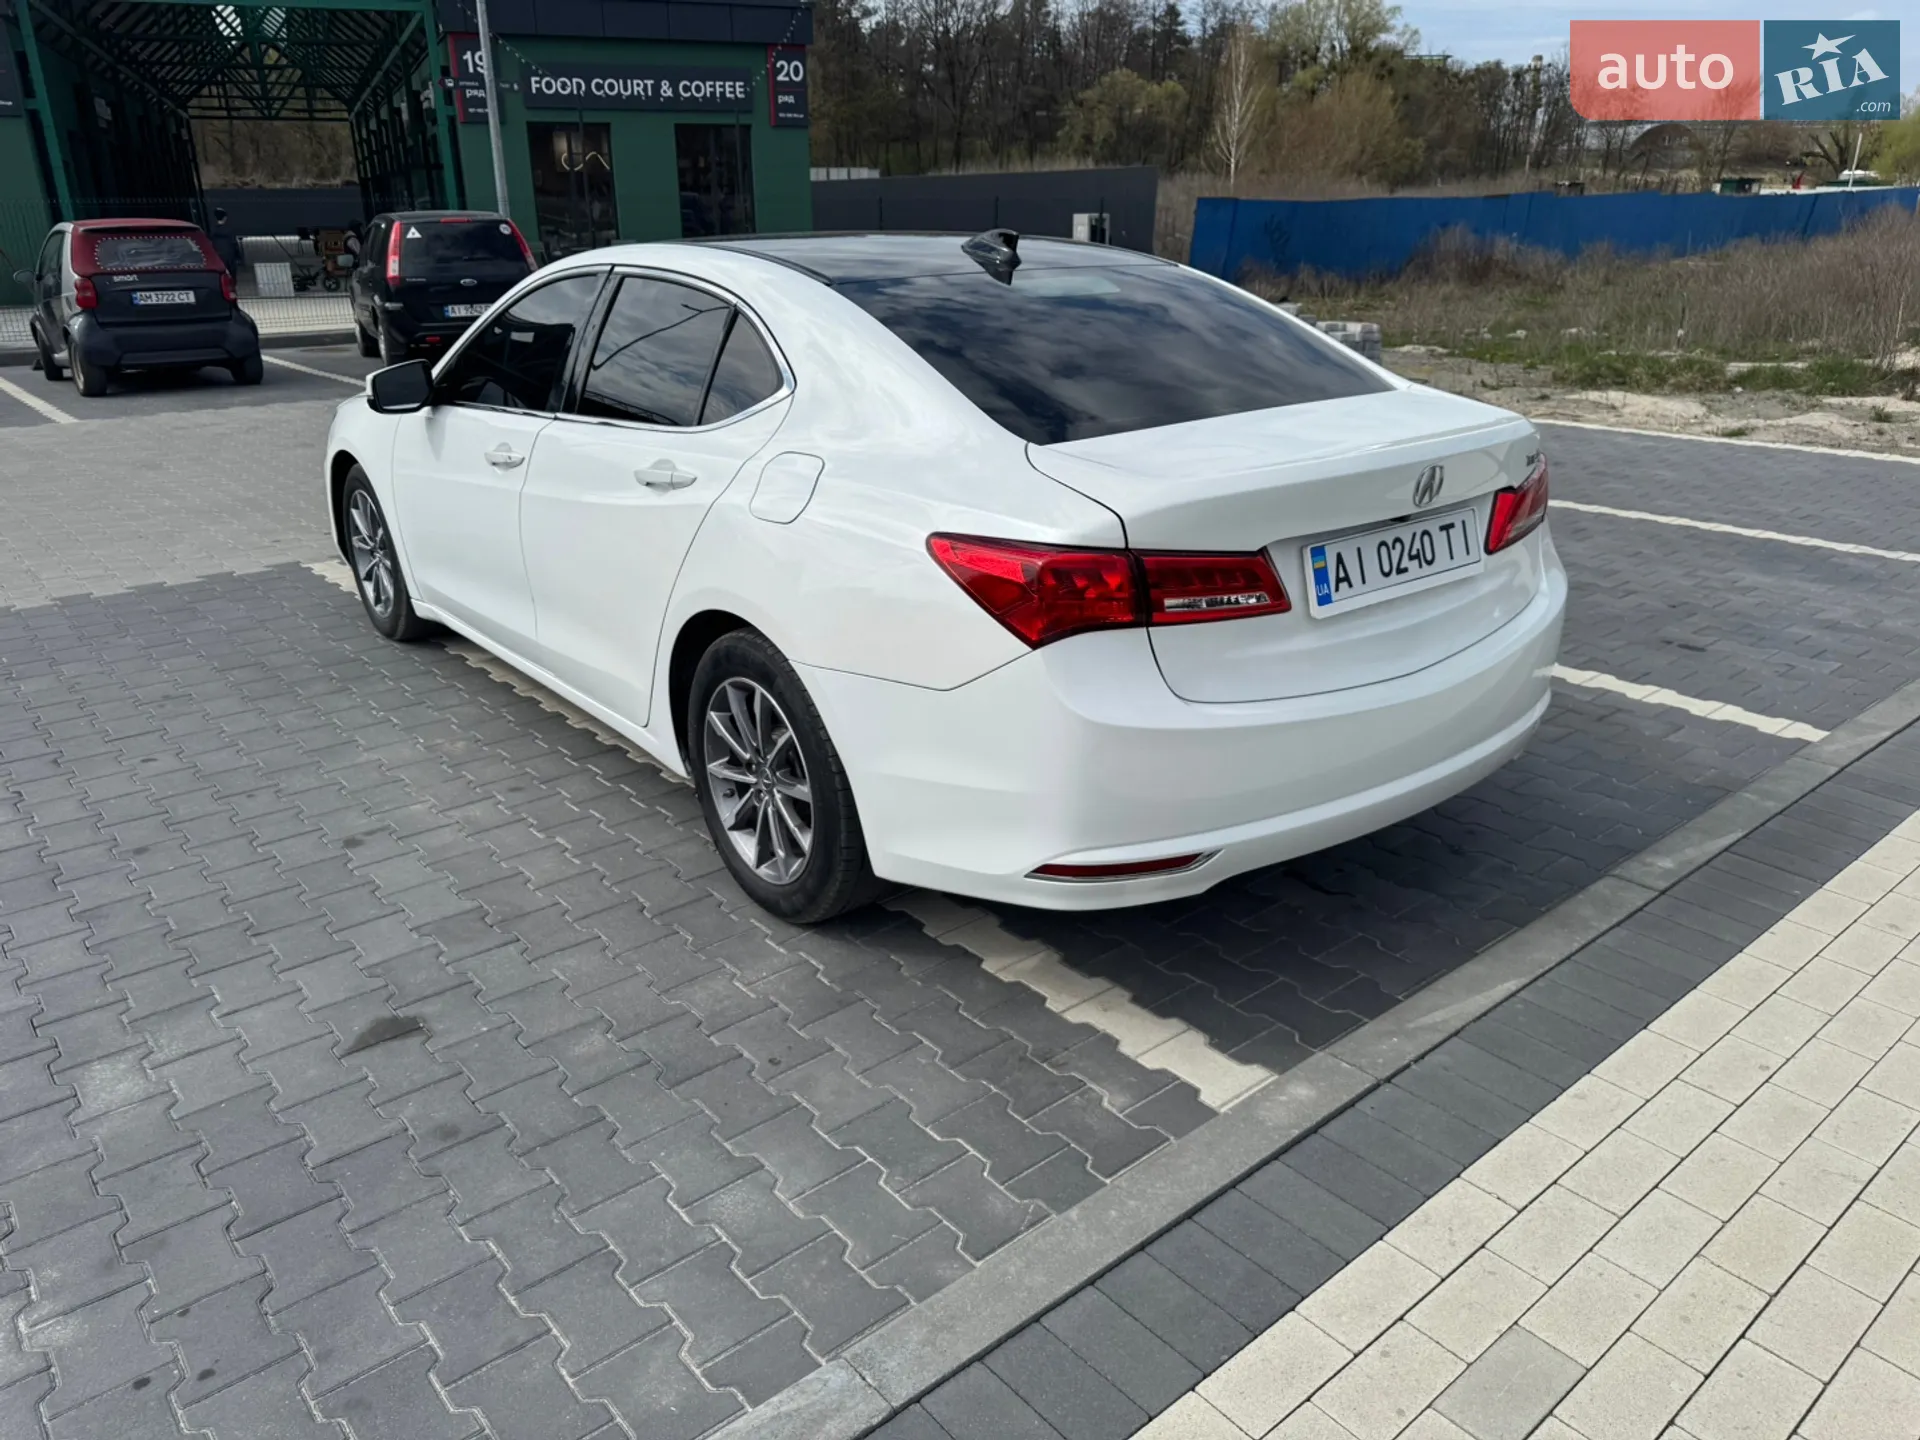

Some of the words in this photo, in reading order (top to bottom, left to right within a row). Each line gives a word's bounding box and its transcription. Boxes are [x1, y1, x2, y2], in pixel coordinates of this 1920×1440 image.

[776, 60, 804, 82] 20
[591, 79, 653, 96] COURT
[660, 81, 673, 98] &
[679, 80, 745, 98] COFFEE
[112, 274, 138, 282] smart
[139, 292, 153, 302] AM
[155, 292, 176, 302] 3722
[178, 292, 191, 301] CT
[1334, 546, 1366, 593] AI
[1377, 528, 1436, 578] 0240
[1439, 519, 1471, 560] TI
[1316, 583, 1330, 596] UA
